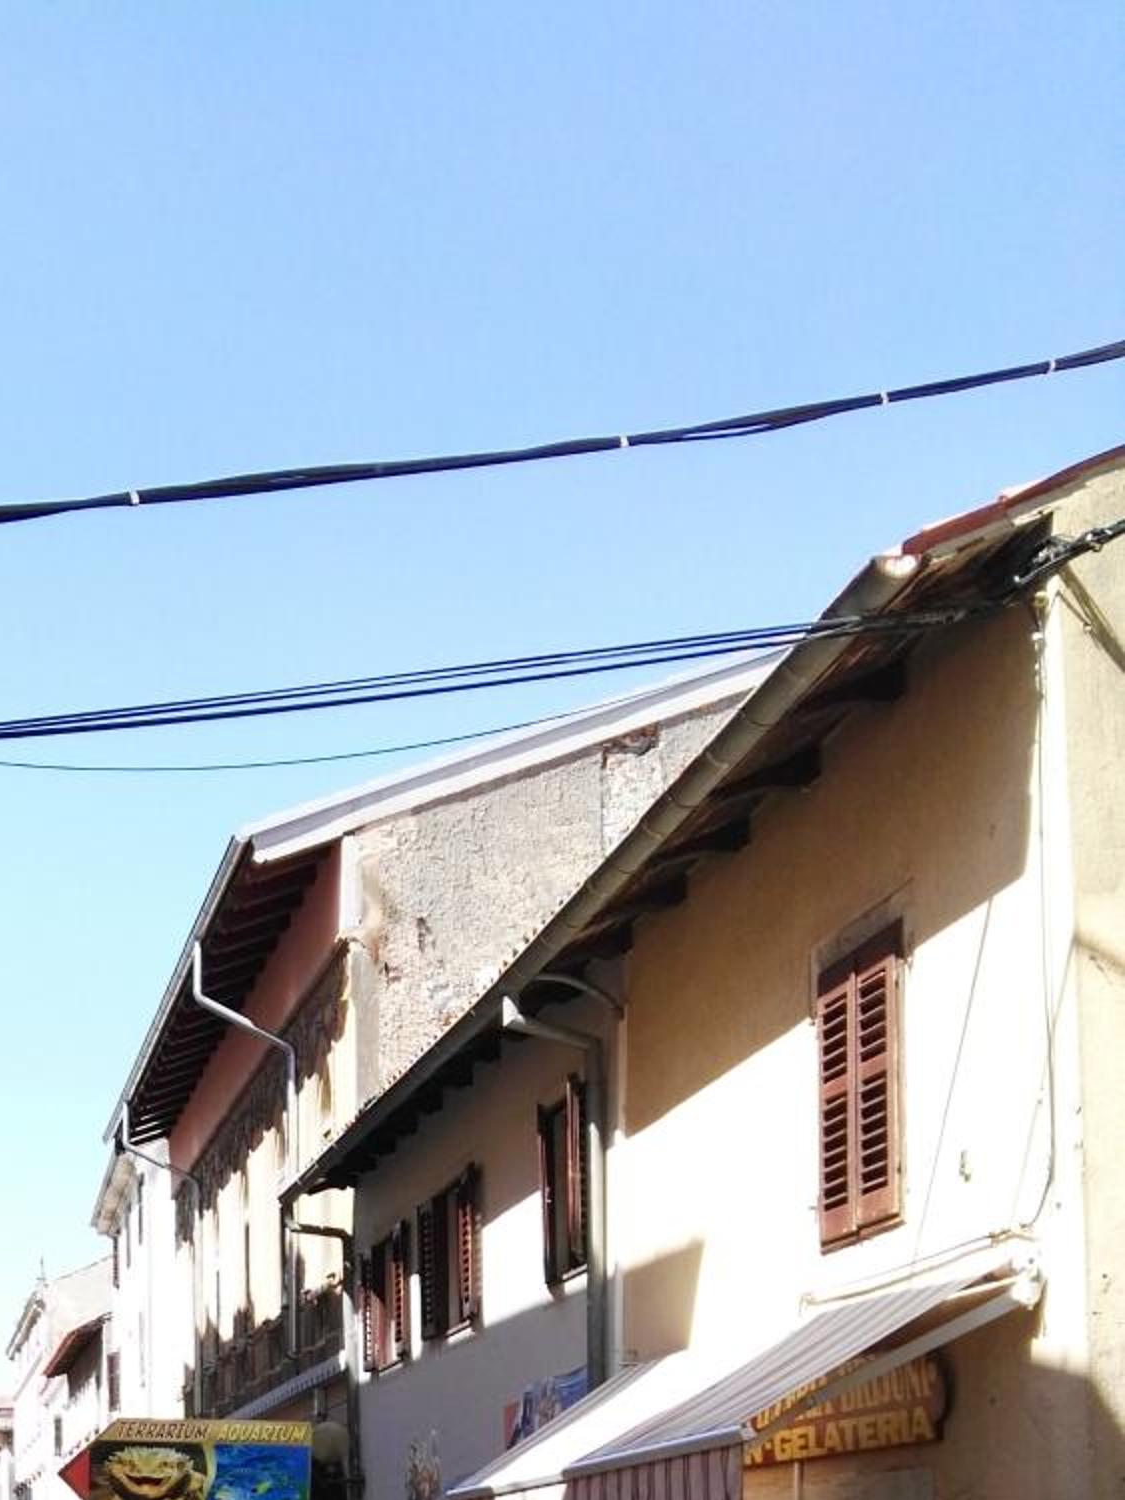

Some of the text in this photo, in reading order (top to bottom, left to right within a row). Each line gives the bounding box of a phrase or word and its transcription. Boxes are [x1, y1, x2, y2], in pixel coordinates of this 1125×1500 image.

[117, 1420, 307, 1441] TERRARIUM AQUARIUM
[775, 1405, 938, 1462] GELATERIA
